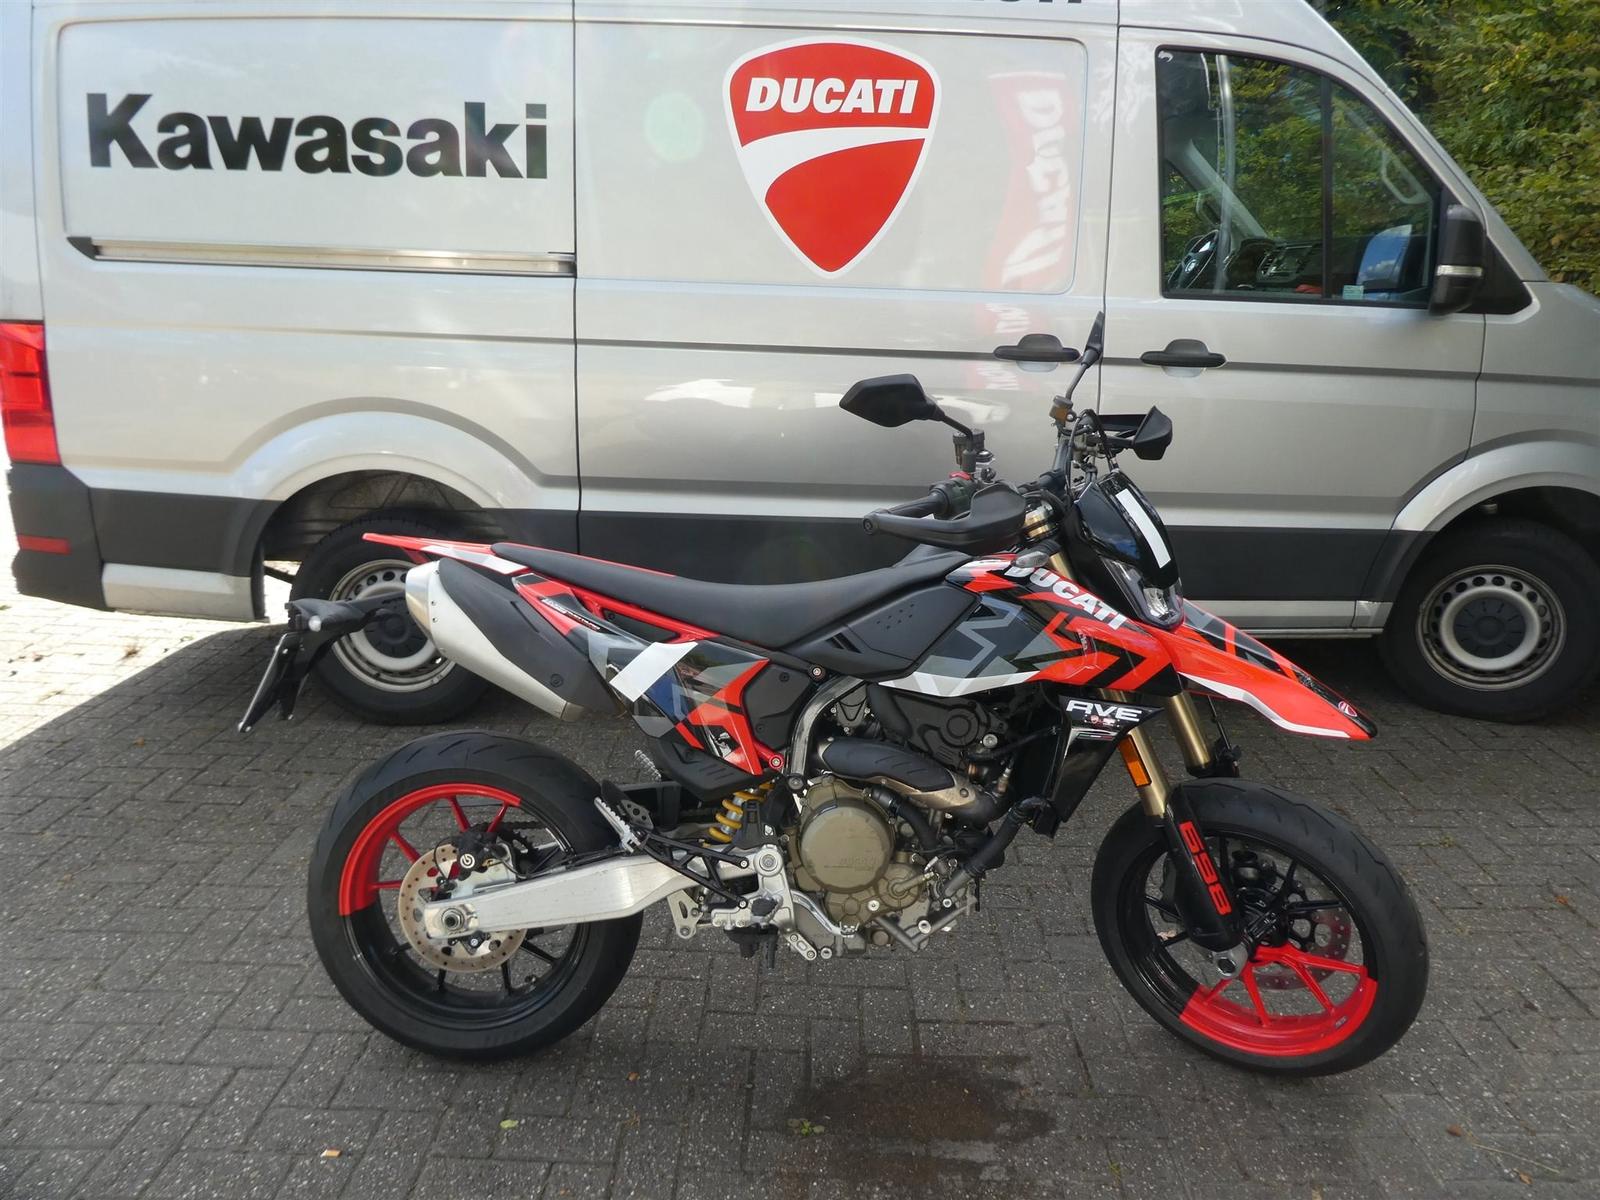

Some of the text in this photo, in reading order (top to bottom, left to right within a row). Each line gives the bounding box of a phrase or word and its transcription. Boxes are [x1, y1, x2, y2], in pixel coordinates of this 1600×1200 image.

[745, 77, 919, 114] DUCATI
[86, 92, 548, 179] Kawasaki
[1004, 567, 1128, 630] DUCATI
[1179, 821, 1232, 916] 698
